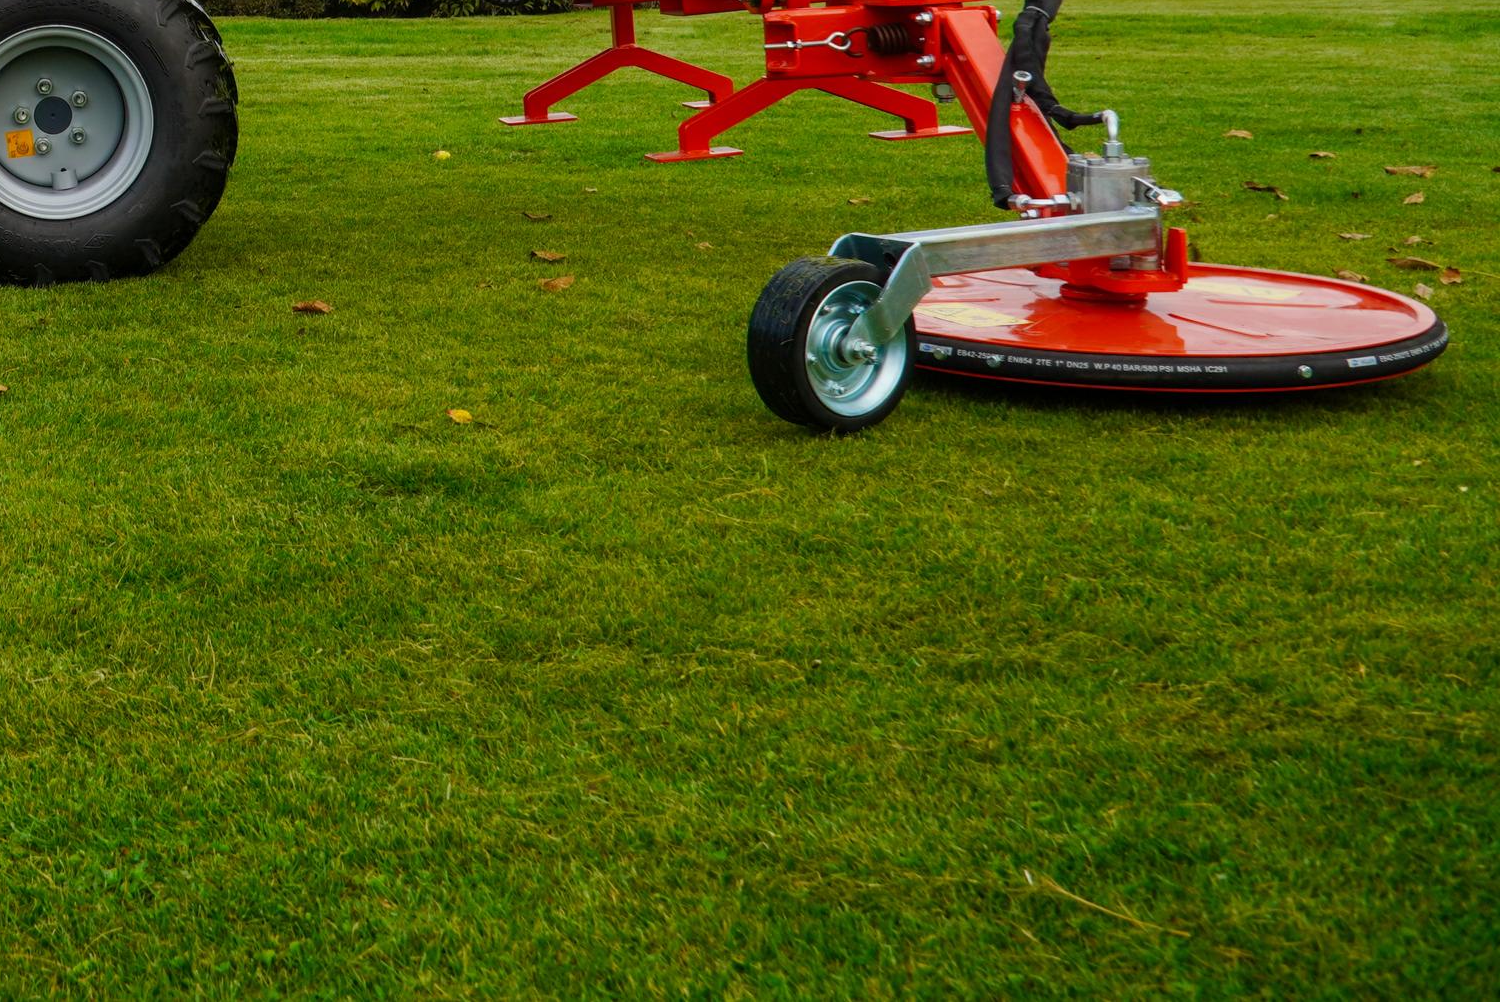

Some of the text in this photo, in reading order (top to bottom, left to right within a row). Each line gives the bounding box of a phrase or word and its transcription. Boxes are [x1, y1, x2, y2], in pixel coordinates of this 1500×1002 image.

[1036, 358, 1052, 367] 2TE
[1066, 360, 1089, 369] DN25
[1112, 363, 1122, 371] 40
[1159, 365, 1174, 373] PSI
